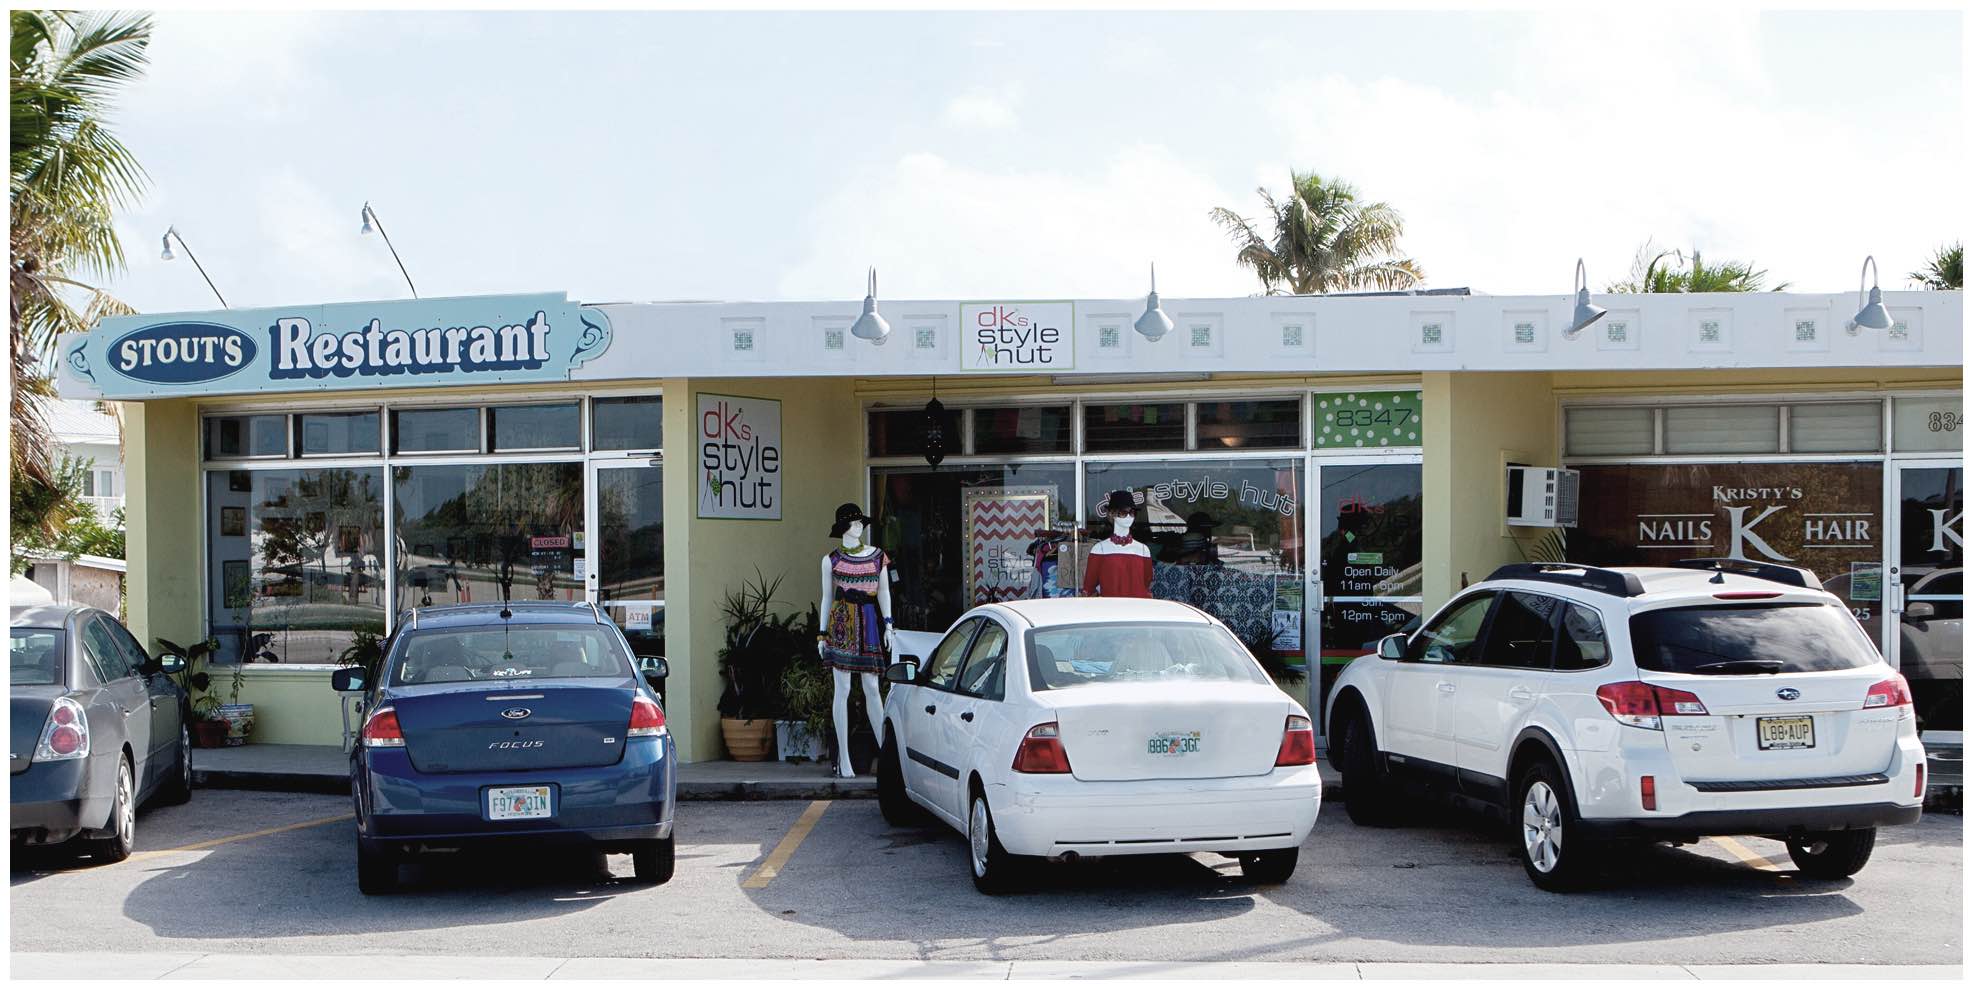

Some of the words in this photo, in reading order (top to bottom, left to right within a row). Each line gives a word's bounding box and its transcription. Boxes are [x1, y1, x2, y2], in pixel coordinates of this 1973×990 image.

[120, 335, 243, 372] STOUT'S
[277, 310, 550, 371] Restaurant
[977, 322, 1060, 348] style
[994, 343, 1052, 364] hut
[1336, 408, 1412, 427] 8347
[703, 436, 779, 480] style
[719, 470, 772, 509] hut
[1154, 475, 1229, 503] style
[1240, 479, 1296, 517] hut
[1712, 485, 1803, 502] KRISTY'S
[1638, 520, 1713, 541] NAILS
[1805, 520, 1871, 541] HAIR
[1722, 504, 1795, 561] K
[533, 538, 566, 546] CLOSED
[1344, 566, 1372, 579] Open
[1374, 566, 1399, 579] Daily
[1340, 580, 1371, 591] 11am
[1379, 580, 1404, 592] 6pm
[628, 612, 649, 621] ATM
[1341, 609, 1372, 622] 12pm
[1380, 610, 1405, 622] 5pm
[488, 740, 545, 750] FOCUS
